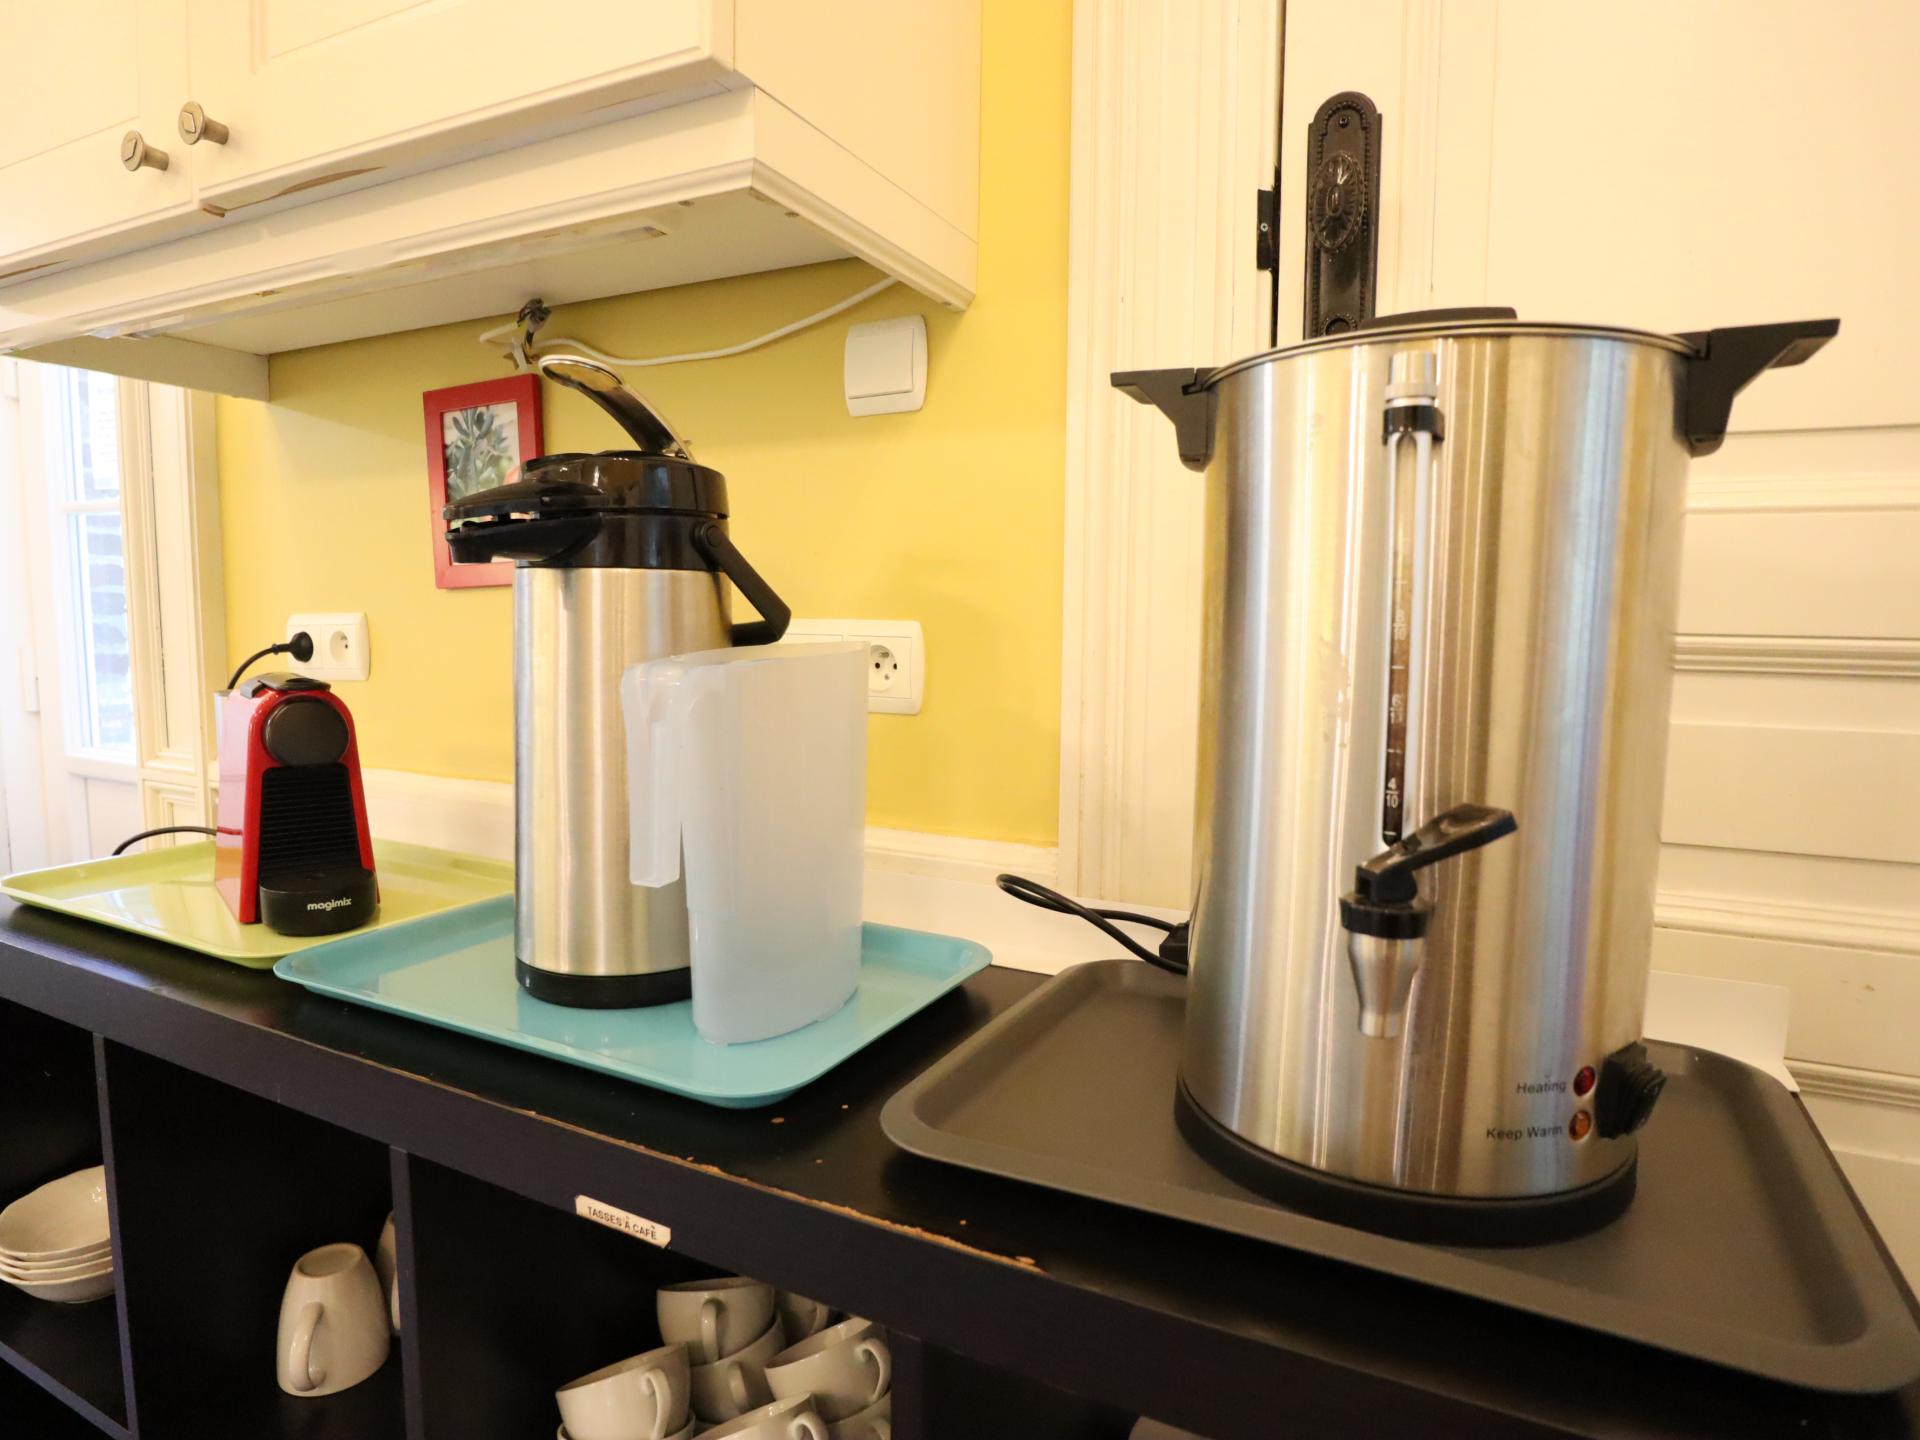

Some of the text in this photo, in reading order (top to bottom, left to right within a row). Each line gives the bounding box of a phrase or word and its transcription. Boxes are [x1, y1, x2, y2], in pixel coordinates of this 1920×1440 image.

[1387, 777, 1397, 790] 4
[1386, 794, 1399, 809] 10
[307, 897, 352, 911] magimix
[1516, 1079, 1567, 1096] Heating
[1486, 1124, 1563, 1142] Keep Warm
[587, 1205, 623, 1227] TASSES
